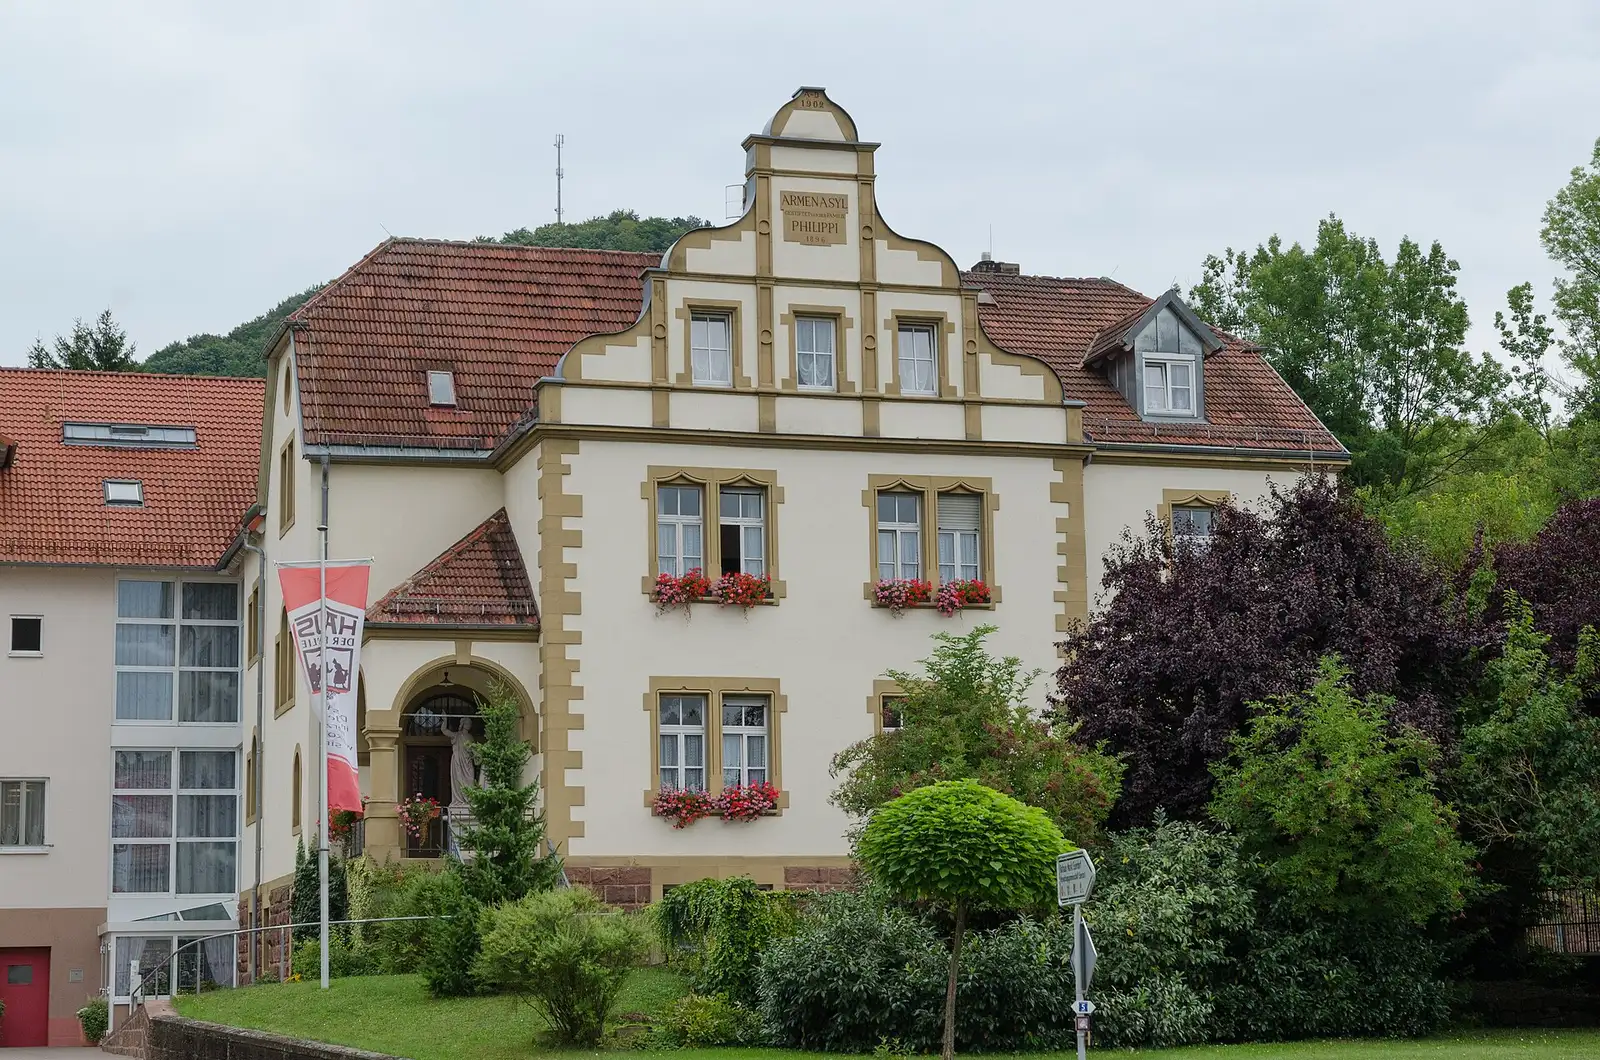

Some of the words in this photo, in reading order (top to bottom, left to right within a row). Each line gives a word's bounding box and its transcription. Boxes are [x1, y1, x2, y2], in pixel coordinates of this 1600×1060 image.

[800, 99, 824, 109] 1902
[781, 194, 848, 209] ARMENASYL
[791, 220, 838, 234] PHILIPPI
